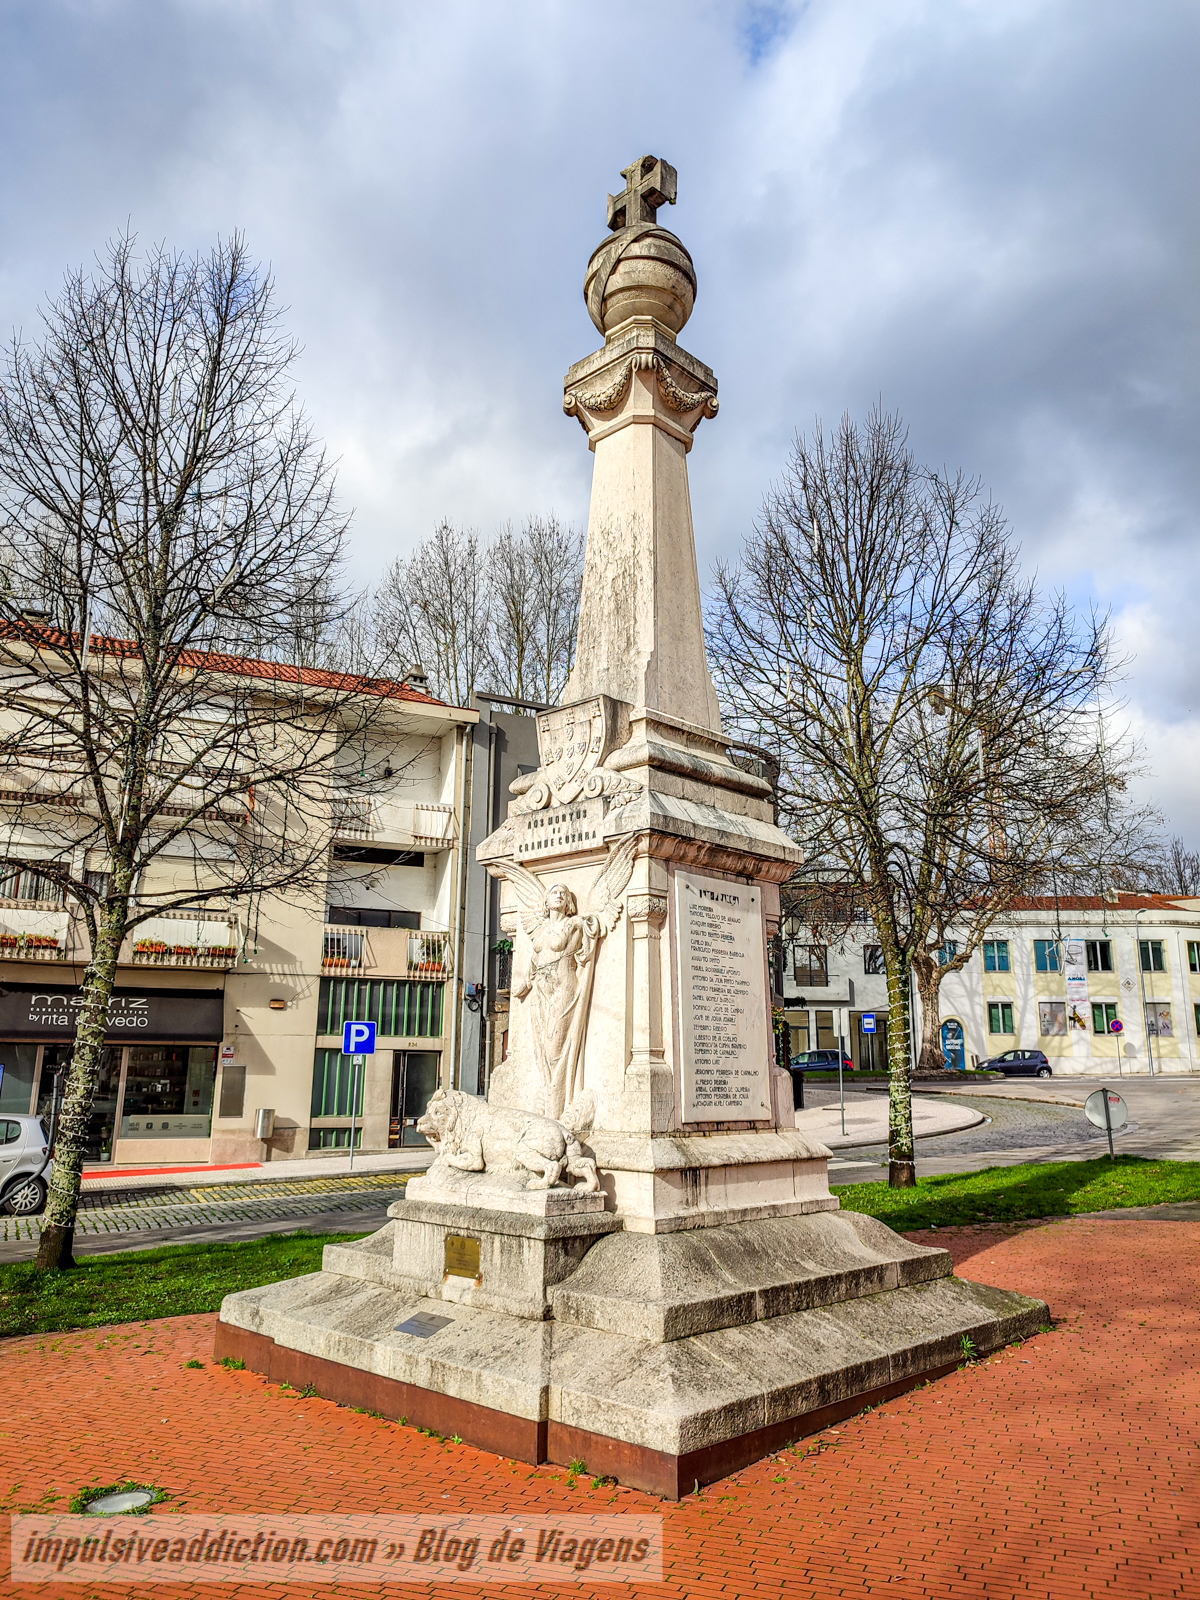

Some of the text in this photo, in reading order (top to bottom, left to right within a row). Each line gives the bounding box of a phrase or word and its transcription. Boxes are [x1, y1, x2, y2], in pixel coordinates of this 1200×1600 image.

[31, 994, 150, 1008] mariz
[28, 1014, 40, 1022] by
[42, 1014, 68, 1025] rita
[350, 1024, 370, 1052] P
